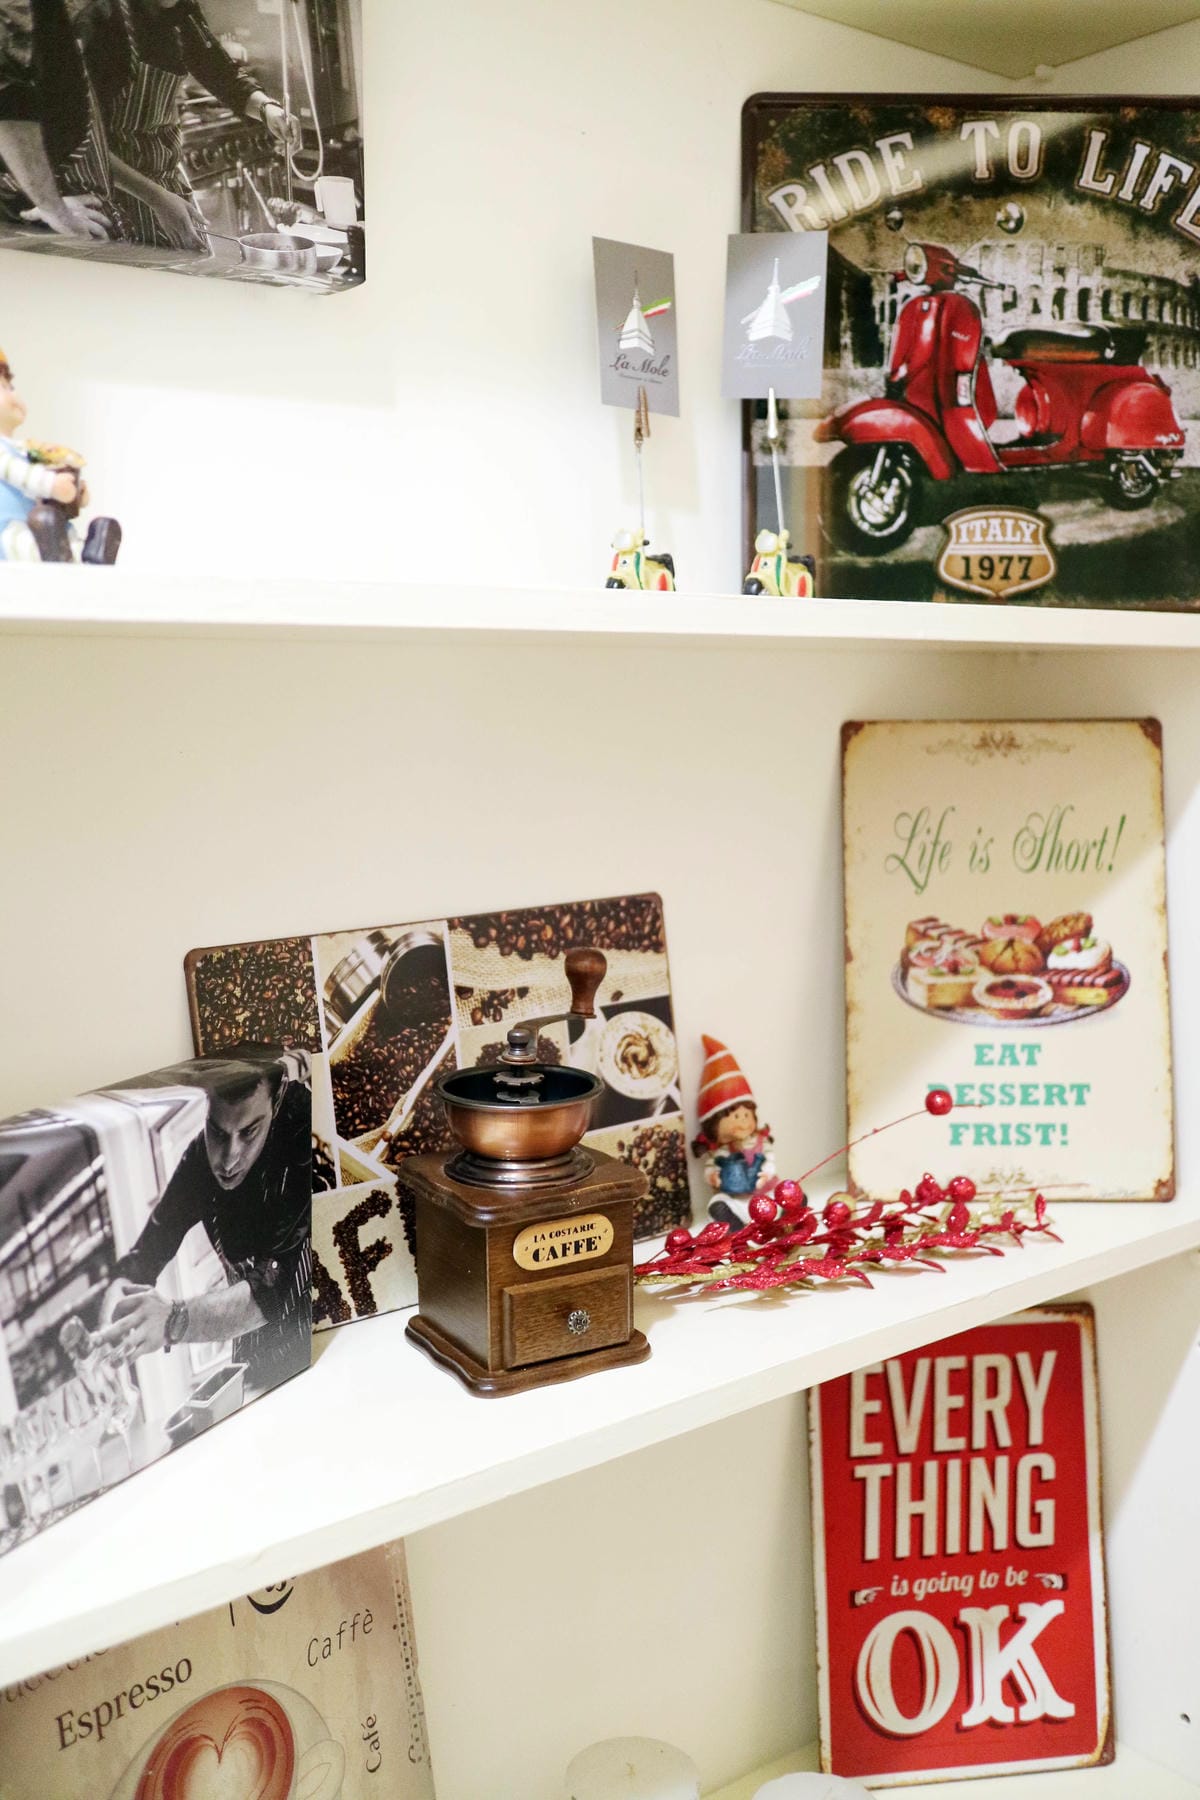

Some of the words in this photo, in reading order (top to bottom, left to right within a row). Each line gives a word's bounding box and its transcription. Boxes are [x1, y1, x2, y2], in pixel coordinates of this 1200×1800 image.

[768, 132, 922, 232] RIDE
[959, 119, 1041, 179] TO
[609, 353, 630, 371] La
[632, 354, 671, 377] Mole
[959, 518, 1038, 544] ITALY
[961, 556, 1034, 581] 1977
[884, 805, 956, 895] Life
[969, 826, 995, 874] is
[1012, 803, 1126, 874] Short!
[973, 1043, 1042, 1067] EAT
[948, 1123, 1069, 1147] FRIST!
[533, 1233, 547, 1244] LA
[850, 1350, 1058, 1457] EVERY
[854, 1452, 1056, 1561] THING
[890, 1574, 910, 1597] is
[912, 1571, 975, 1601] going
[978, 1569, 999, 1589] to
[1004, 1565, 1029, 1587] be
[306, 1608, 374, 1668] Caffè
[856, 1600, 1076, 1735] OK
[55, 1656, 193, 1752] Espresso
[361, 1713, 383, 1774] Café
